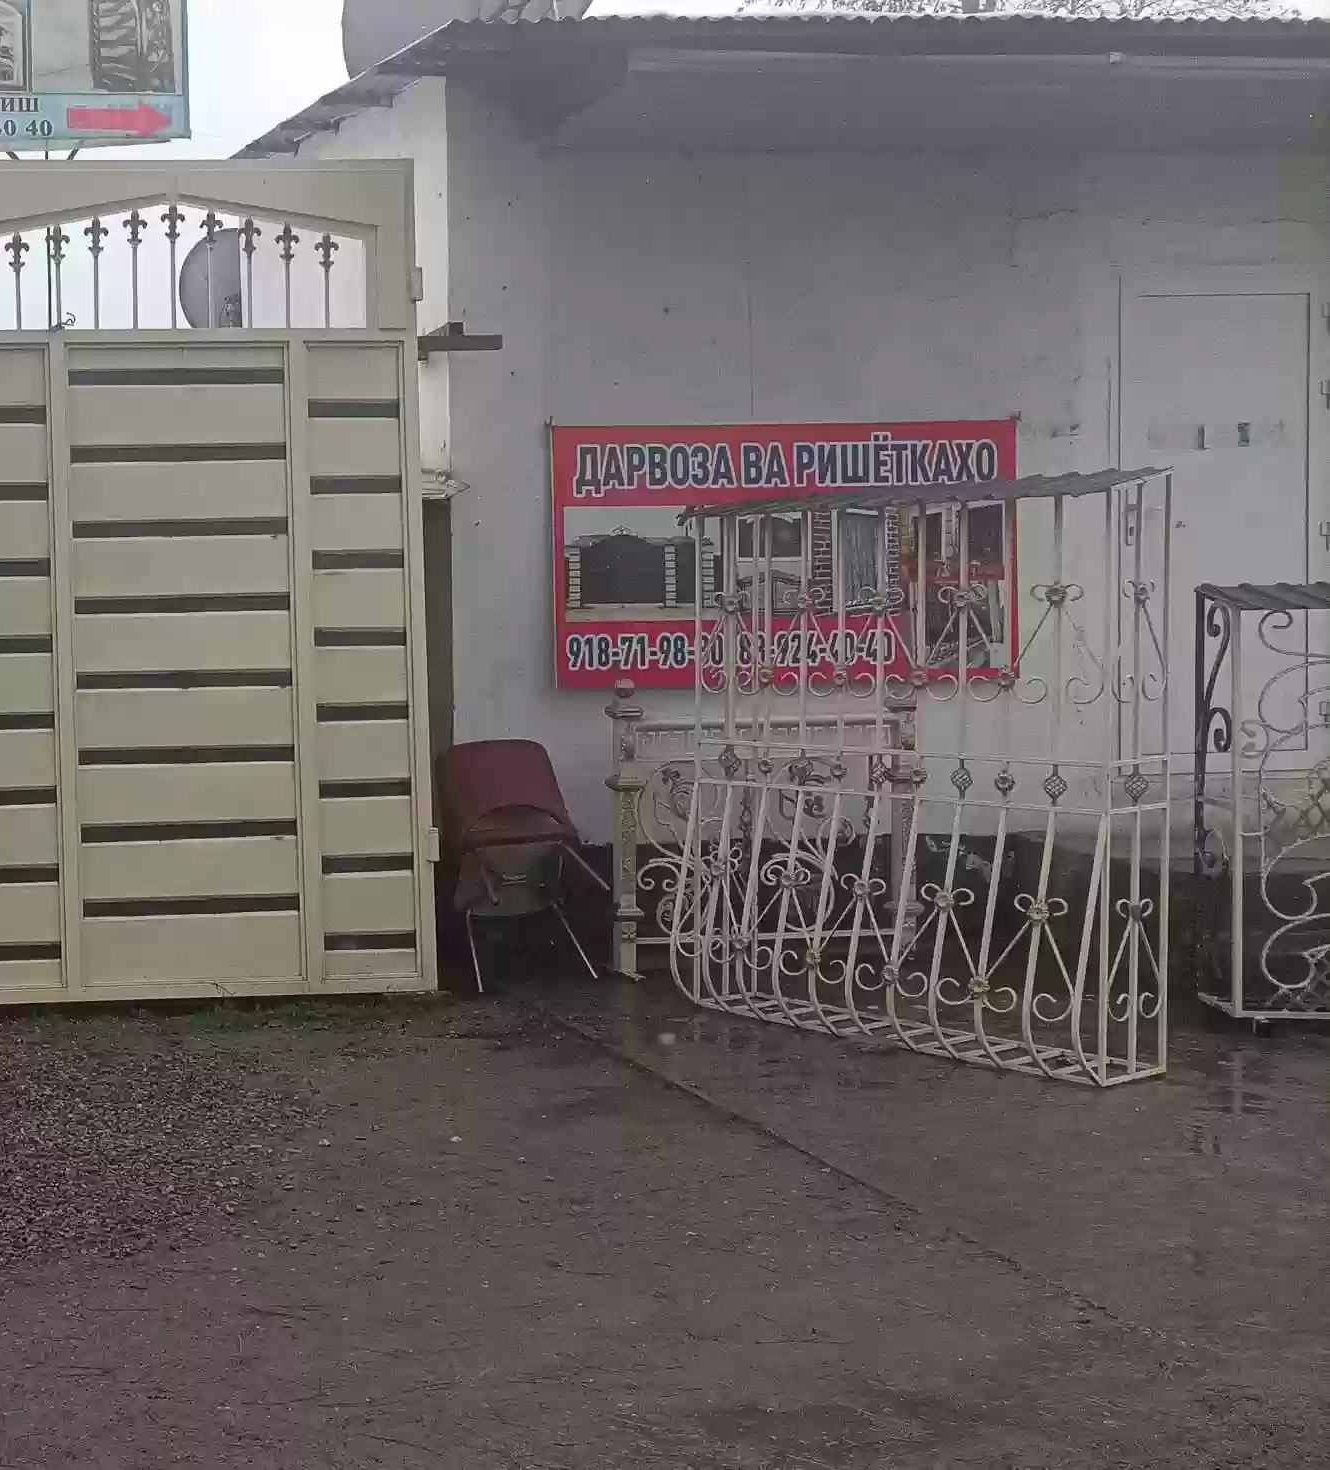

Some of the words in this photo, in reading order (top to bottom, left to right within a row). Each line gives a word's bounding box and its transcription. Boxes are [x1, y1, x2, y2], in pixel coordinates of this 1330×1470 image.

[25, 119, 53, 136] 40
[573, 443, 734, 497] ДАРВОЗА
[741, 442, 790, 487] ВА
[794, 432, 998, 487] РИШЁТКАХО
